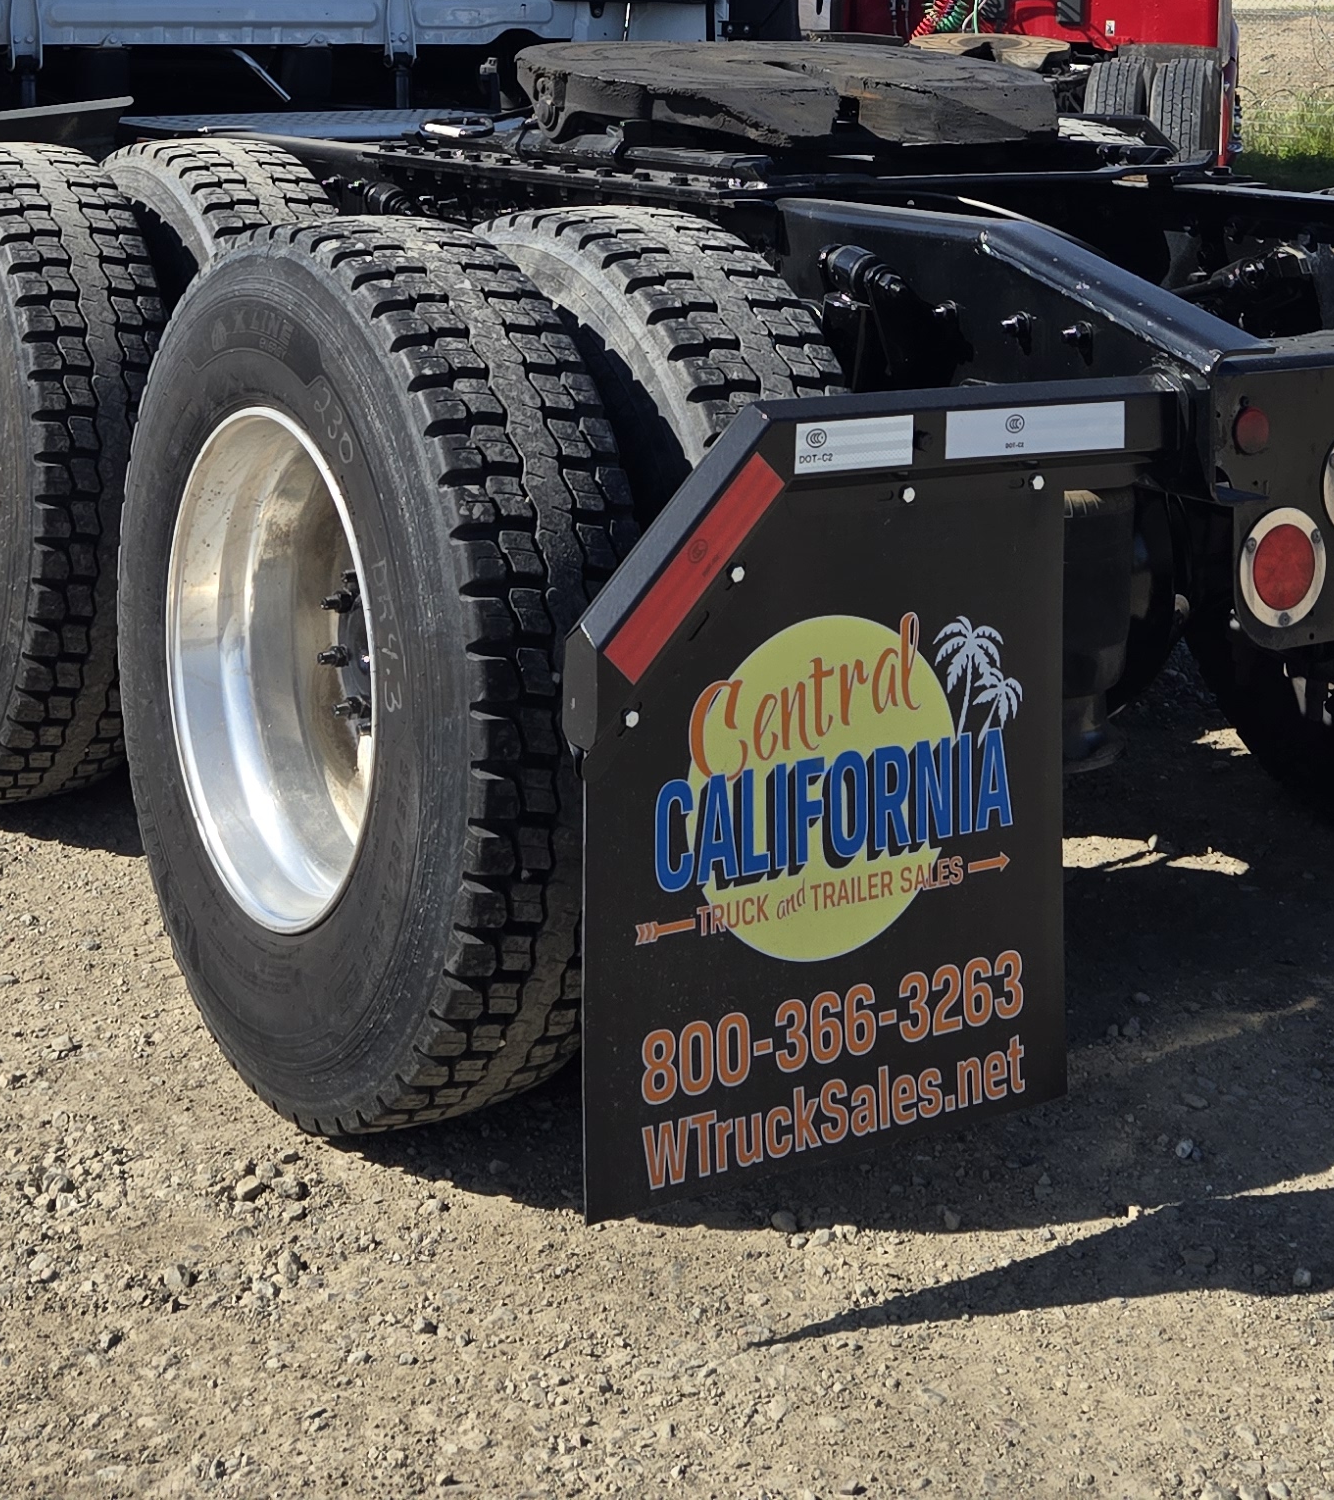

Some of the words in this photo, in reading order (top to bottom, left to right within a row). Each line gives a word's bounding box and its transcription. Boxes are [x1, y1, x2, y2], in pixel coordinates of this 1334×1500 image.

[249, 307, 295, 348] LINE
[798, 452, 834, 464] DOT-C2
[690, 612, 921, 783] Central
[655, 728, 1014, 892] CALIFORNIA
[697, 888, 770, 938] TRUCK
[776, 877, 807, 922] and
[810, 875, 895, 919] TRAILER
[898, 856, 965, 893] SALES
[641, 950, 1024, 1106] 800-366-3263
[642, 1036, 1026, 1191] WTruckSales.net
